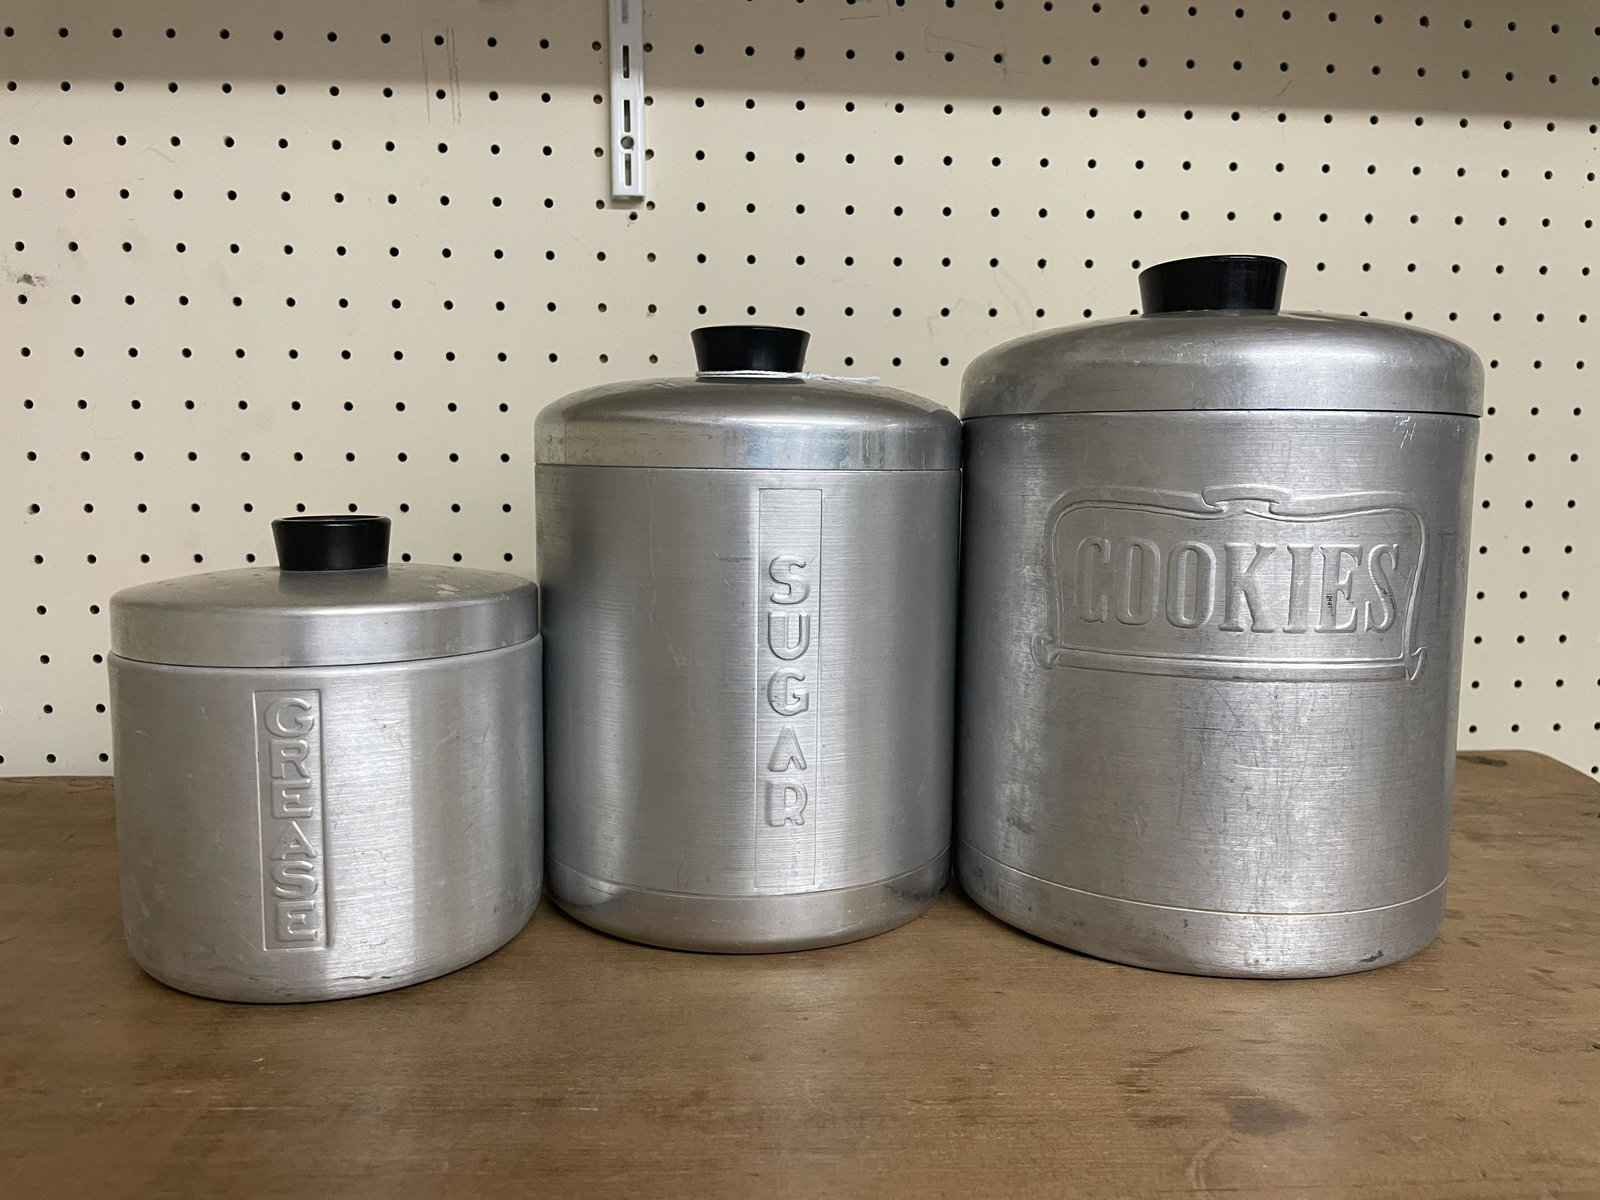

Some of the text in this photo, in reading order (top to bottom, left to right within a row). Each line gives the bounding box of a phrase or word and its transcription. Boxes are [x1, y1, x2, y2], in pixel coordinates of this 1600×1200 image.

[765, 554, 811, 828] SUGAR
[1075, 535, 1400, 634] COOKIES
[263, 697, 319, 942] GREASE
